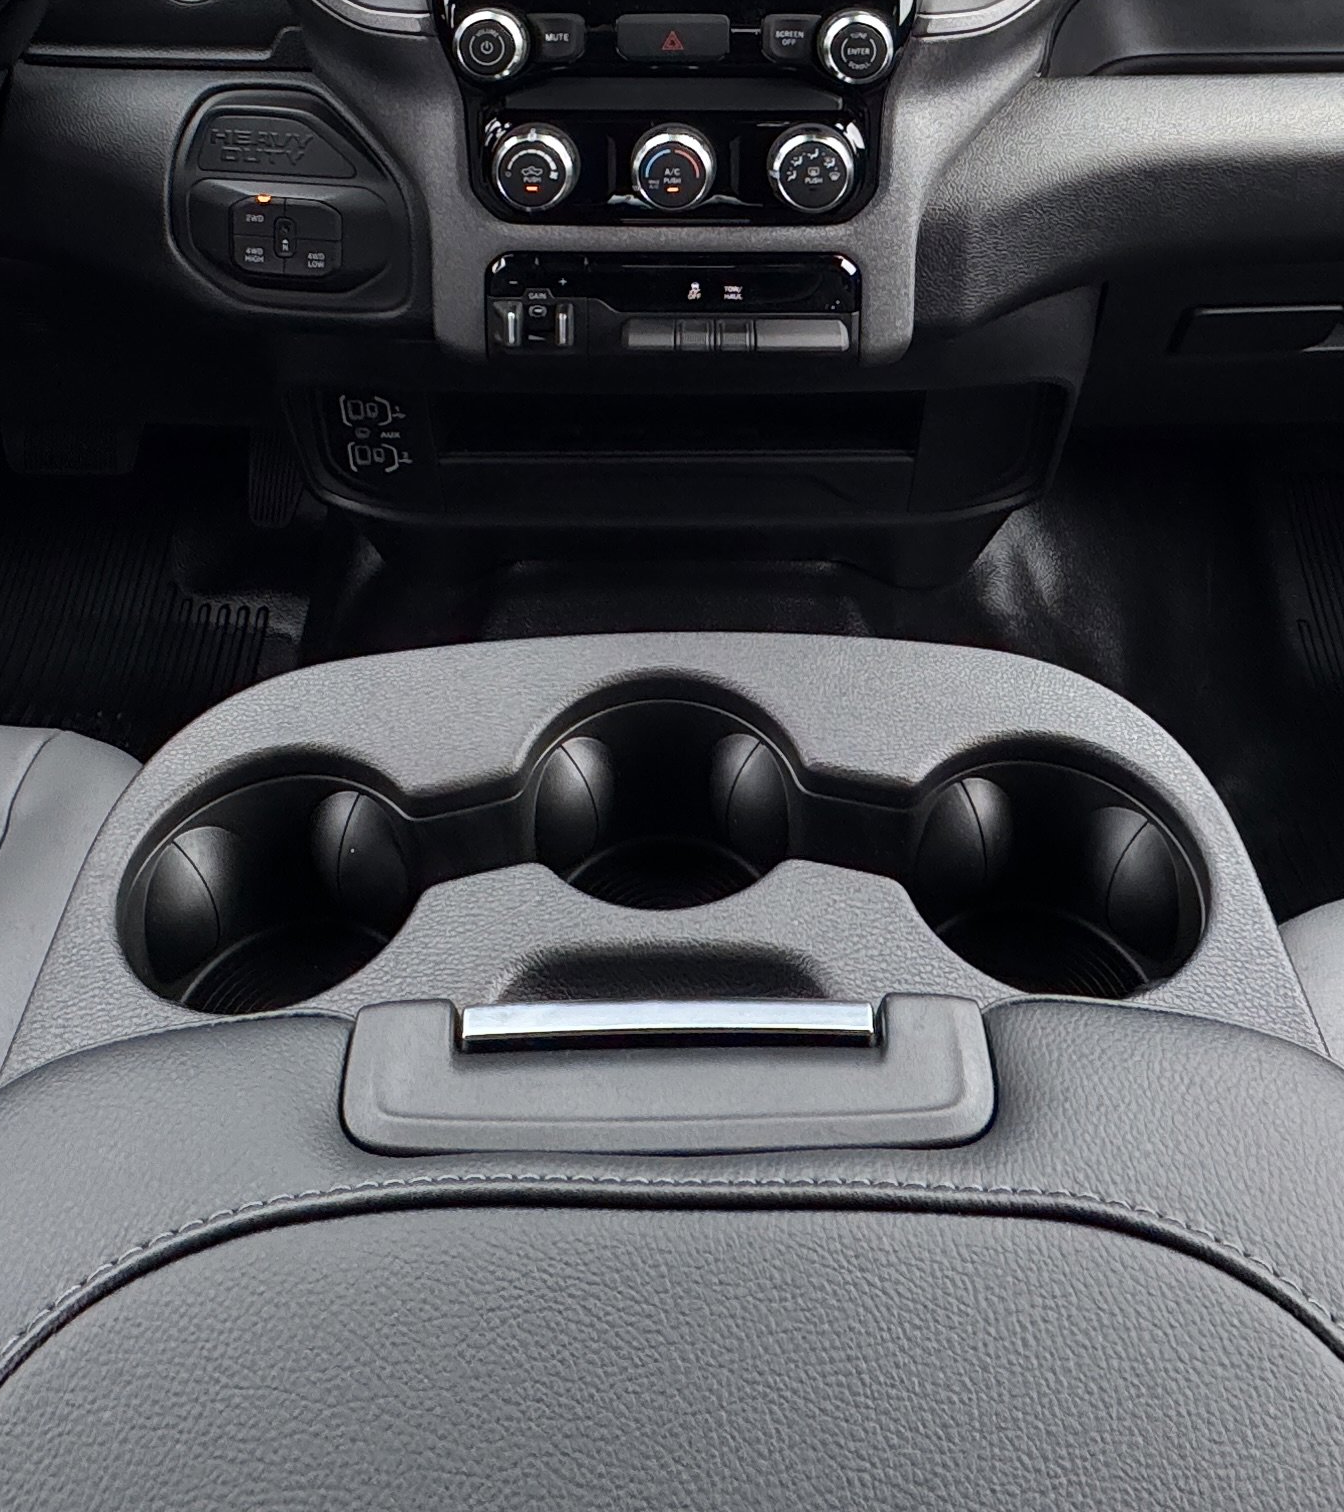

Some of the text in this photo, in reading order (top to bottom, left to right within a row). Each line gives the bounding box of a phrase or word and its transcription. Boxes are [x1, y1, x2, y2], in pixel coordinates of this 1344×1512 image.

[545, 33, 569, 42] MUTE
[775, 30, 804, 38] SCREEN
[782, 38, 796, 46] OFF
[210, 128, 315, 148] HEAVY
[221, 146, 305, 166] DUTY
[664, 167, 680, 176] A/C
[246, 214, 264, 223] 2WD
[307, 252, 325, 260] 4WD
[307, 260, 325, 268] LOW
[528, 292, 547, 300] GAIN
[688, 292, 701, 300] OFF
